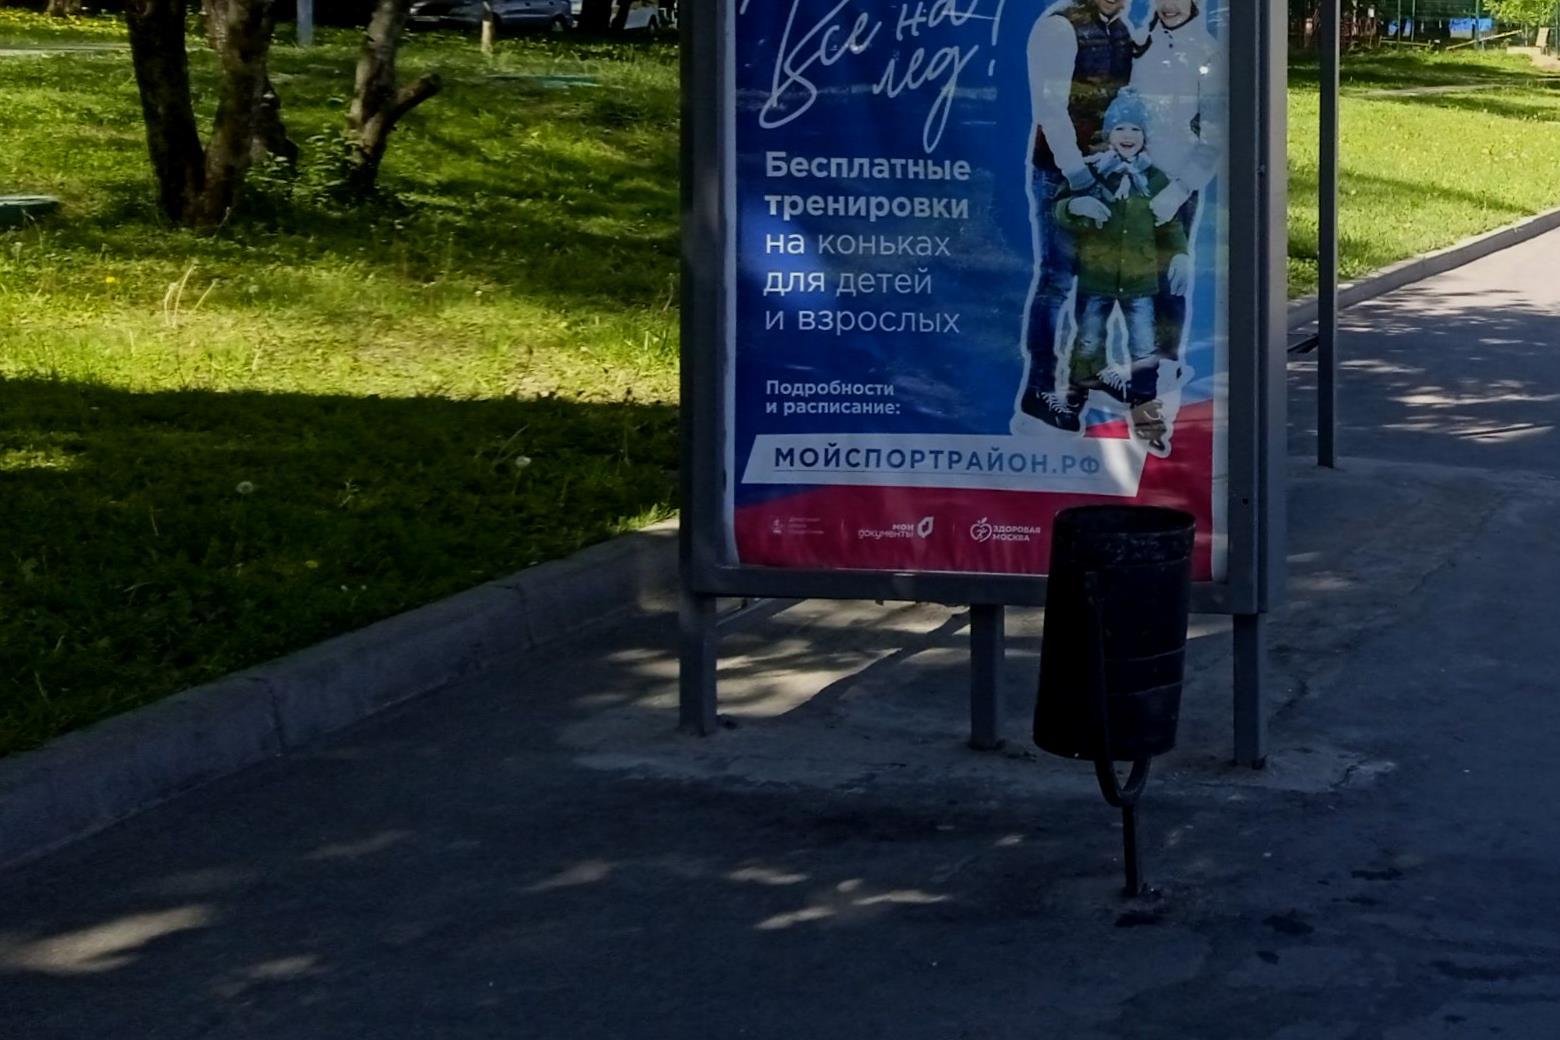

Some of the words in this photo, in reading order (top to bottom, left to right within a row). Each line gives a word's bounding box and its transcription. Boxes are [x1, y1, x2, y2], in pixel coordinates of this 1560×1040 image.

[765, 151, 971, 181] Бесплатные
[764, 194, 969, 222] тренировки
[765, 234, 805, 255] на
[818, 233, 951, 257] коньках
[763, 271, 825, 296] для
[836, 267, 932, 295] детей
[765, 310, 784, 331] и
[798, 310, 960, 336] взрослых
[765, 380, 895, 401] Подробности
[765, 400, 777, 414] и
[783, 399, 901, 416] расписание:
[774, 442, 1100, 475] МОЙСПОРТРАЙОН.РФ
[993, 525, 1041, 534] ЗДОРОВАЯ
[993, 533, 1030, 542] МОСКВА
